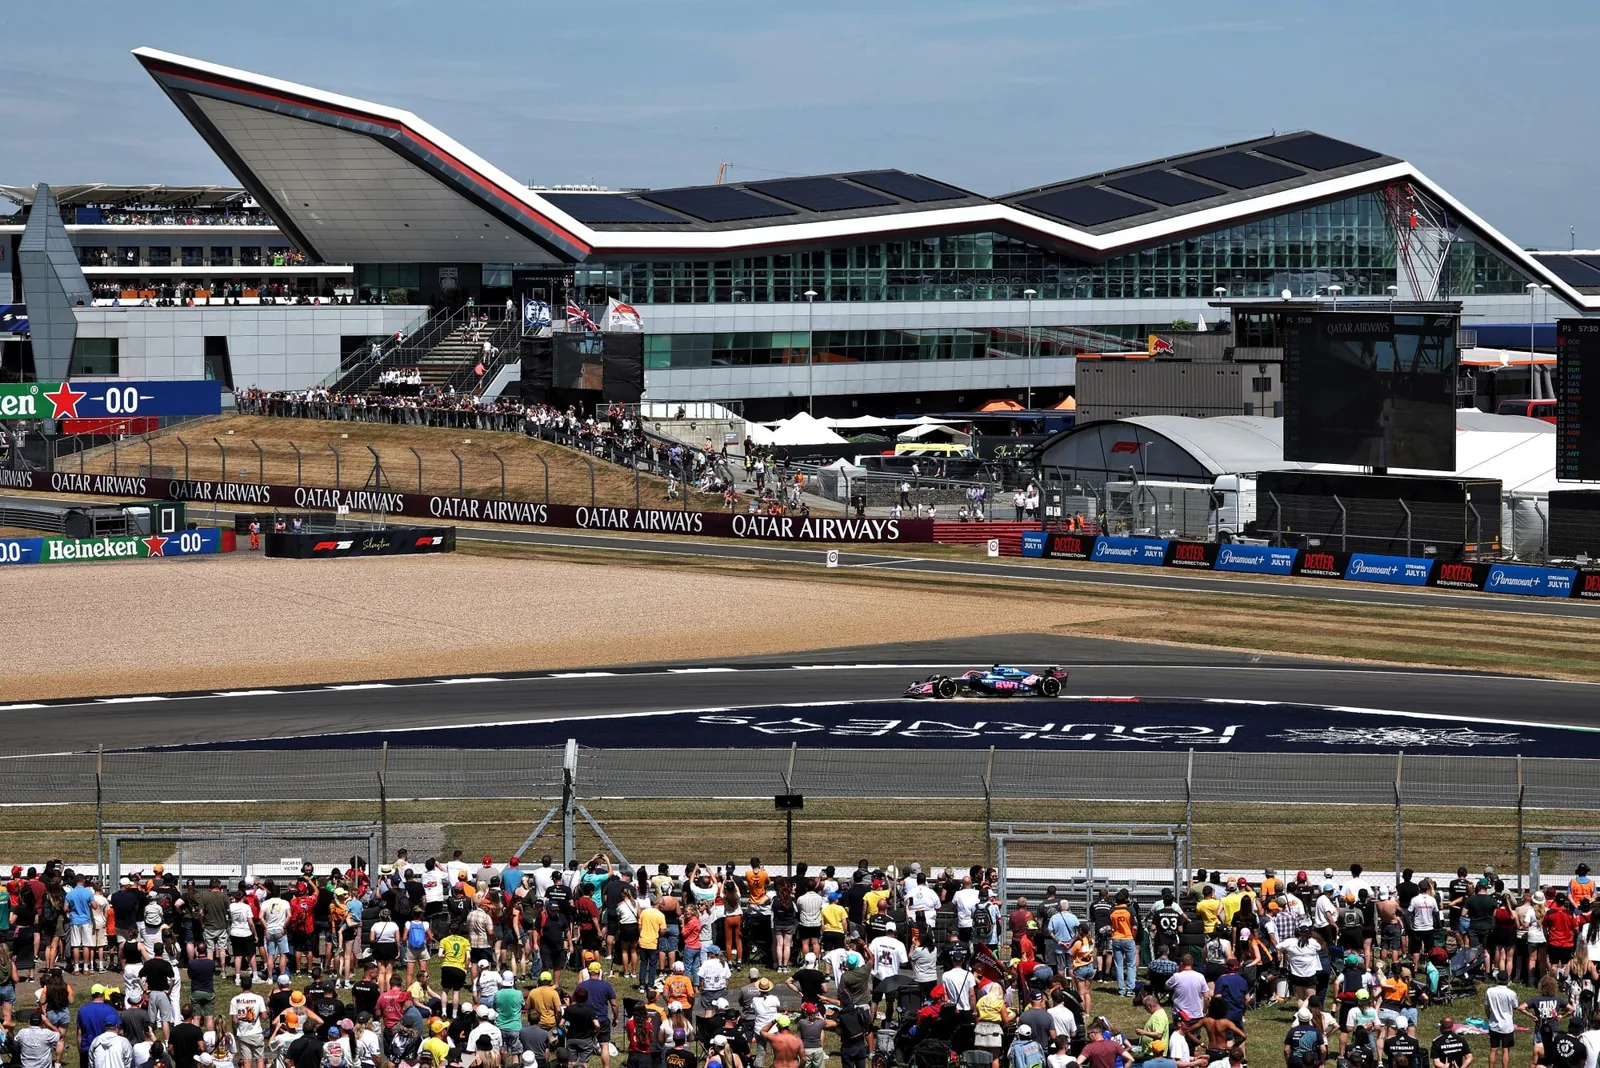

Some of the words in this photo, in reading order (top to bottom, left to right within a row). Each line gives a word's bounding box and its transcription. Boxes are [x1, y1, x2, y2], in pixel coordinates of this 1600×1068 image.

[1327, 323, 1353, 335] QATAR
[1354, 322, 1390, 333] AIRWAYS
[106, 387, 138, 414] 0.0
[51, 472, 91, 492] QATAR
[93, 474, 146, 495] AIRWAYS
[169, 479, 212, 500] QATAR
[215, 482, 270, 503] AIRWAYS
[294, 487, 340, 508] QATAR
[345, 491, 404, 512] AIRWAYS
[430, 496, 479, 518] QATAR
[483, 501, 547, 523] AIRWAYS
[575, 506, 630, 529] QATAR
[633, 509, 703, 532] AIRWAYS
[732, 515, 794, 538] QATAR
[799, 518, 899, 540] AIRWAYS
[49, 538, 138, 559] Heineken
[180, 533, 201, 552] 0.0
[1054, 536, 1081, 552] DEXTER
[1096, 542, 1138, 556] Paramount+
[1176, 544, 1204, 560] DEXTER
[1220, 549, 1264, 565] Paramount+
[1304, 552, 1334, 570] DEXTER
[1350, 559, 1398, 575] Paramount+
[1440, 564, 1472, 582] DEXTER
[1490, 570, 1540, 587] Paramount+
[696, 715, 1243, 735] JOURNEYS
[750, 726, 1233, 744] EXPLORA
[1160, 917, 1178, 930] 03
[453, 943, 460, 956] 9
